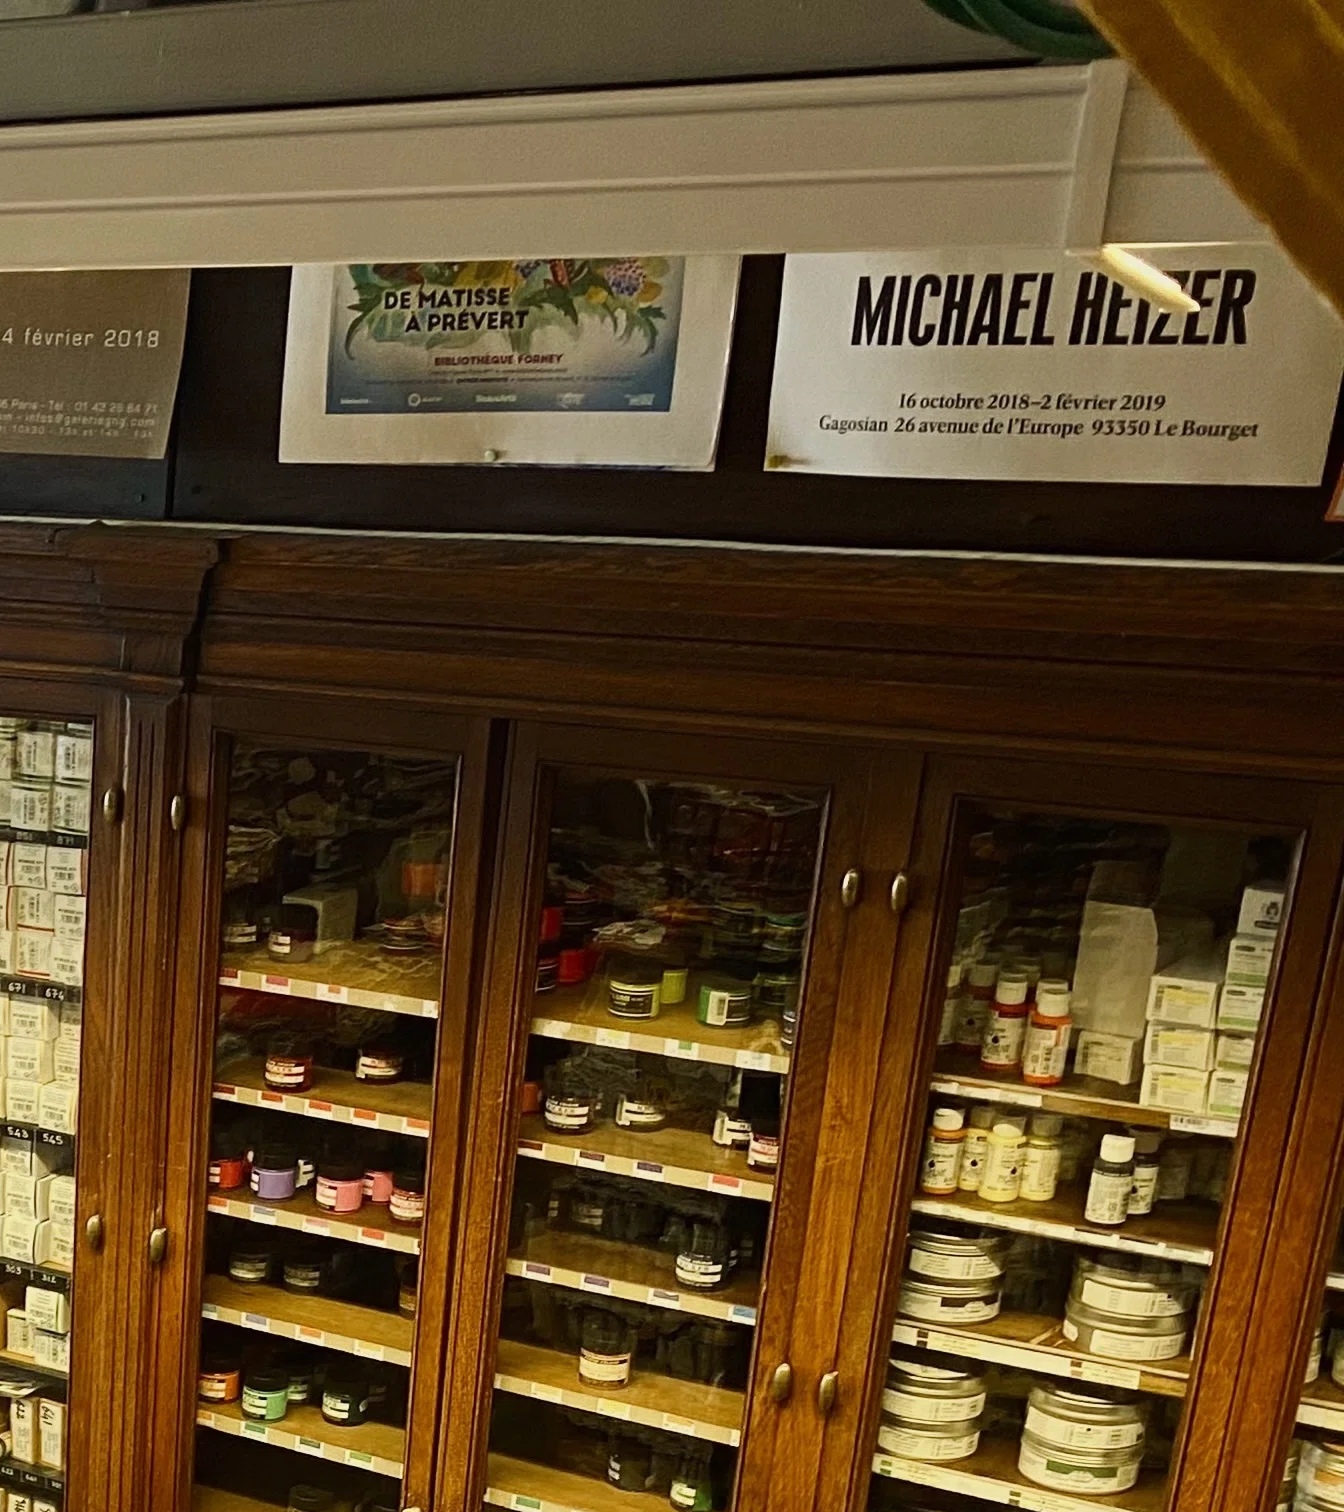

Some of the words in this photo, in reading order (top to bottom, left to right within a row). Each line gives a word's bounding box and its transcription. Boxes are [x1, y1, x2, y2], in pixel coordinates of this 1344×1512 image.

[384, 291, 411, 310] DE
[417, 287, 511, 310] MATISSE
[850, 272, 1056, 348] MICHAEL
[1067, 268, 1258, 346] HEIZER
[426, 308, 530, 332] PRÉVERT
[24, 326, 94, 348] février
[103, 329, 160, 349] 2018
[898, 392, 918, 410] 16
[919, 392, 985, 411] octobre
[1055, 392, 1118, 412] février
[1119, 393, 1167, 412] 2019
[818, 414, 889, 434] Gagosian
[894, 416, 916, 434] 26
[917, 420, 980, 435] avenue
[981, 417, 1004, 435] de
[1091, 420, 1152, 438] 93350
[1153, 419, 1179, 436] Le
[1180, 420, 1260, 442] Bourget
[7, 980, 26, 994] 671
[44, 986, 65, 1001] 674
[41, 1132, 64, 1146] 545
